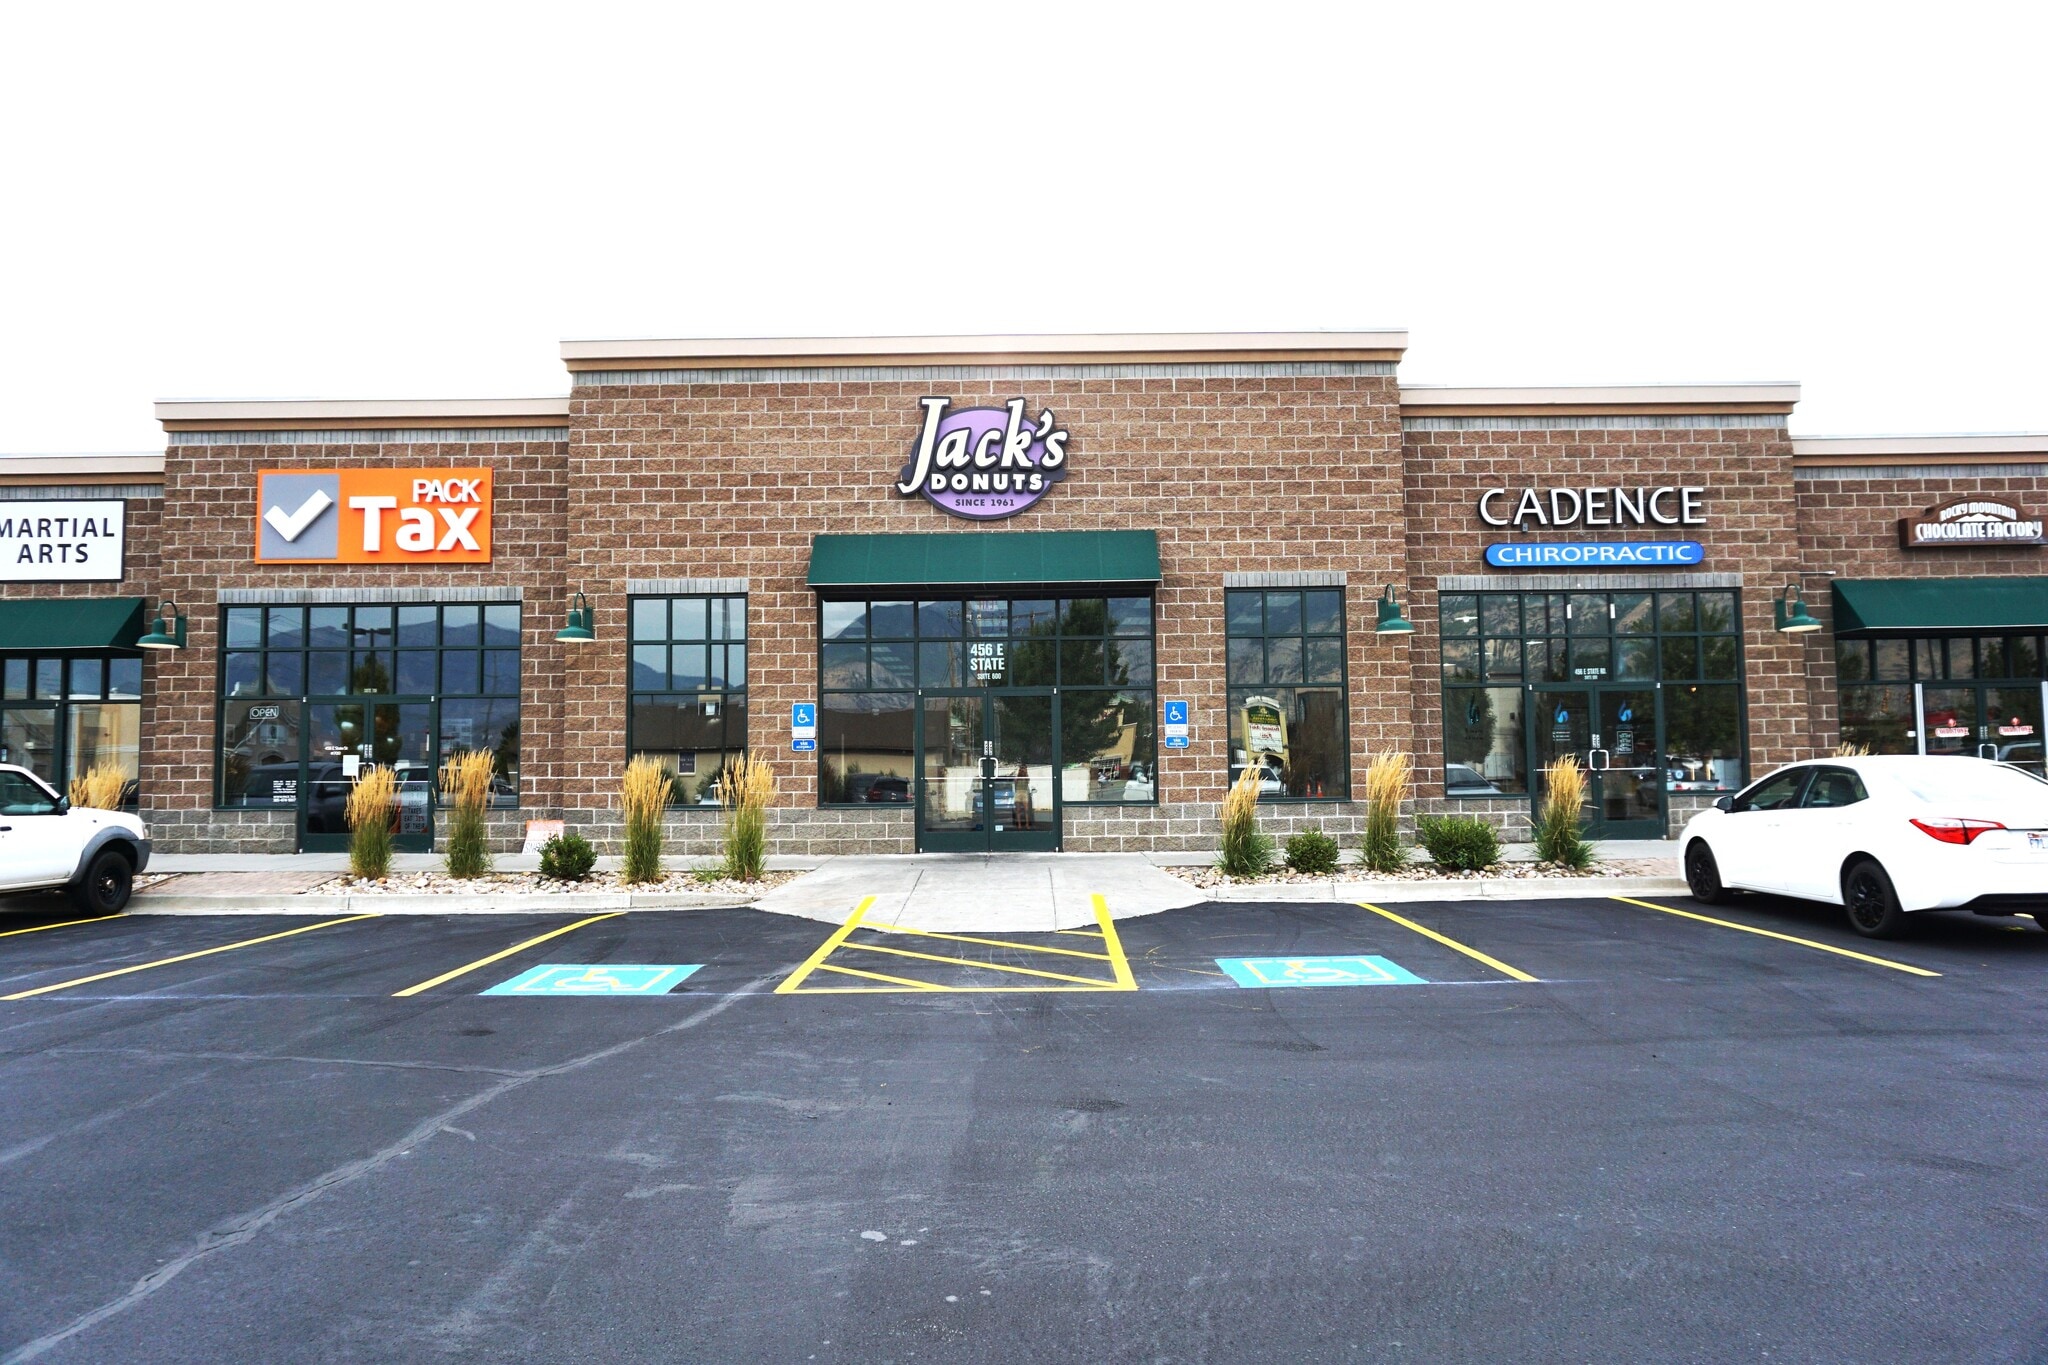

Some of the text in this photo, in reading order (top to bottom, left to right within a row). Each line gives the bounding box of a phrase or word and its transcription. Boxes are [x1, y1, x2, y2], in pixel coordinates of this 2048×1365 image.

[896, 397, 1069, 495] Jack's
[412, 478, 482, 503] PACK
[930, 472, 1043, 491] DONUTS
[955, 498, 1015, 507] SINCE 1961
[1479, 486, 1707, 526] CADENCE
[1940, 501, 2017, 521] ROCKY MOUNTAIN
[0, 517, 115, 538] MARTIAL
[348, 495, 481, 552] Tax
[1915, 521, 2043, 541] CHOCOLATE FACTORY
[16, 543, 89, 564] ARTS
[1497, 545, 1693, 563] CHIROPRACTIC
[970, 643, 1004, 656] 456 E
[970, 657, 1005, 671] STATE
[976, 672, 991, 680] SUITE
[251, 708, 278, 718] OPEN
